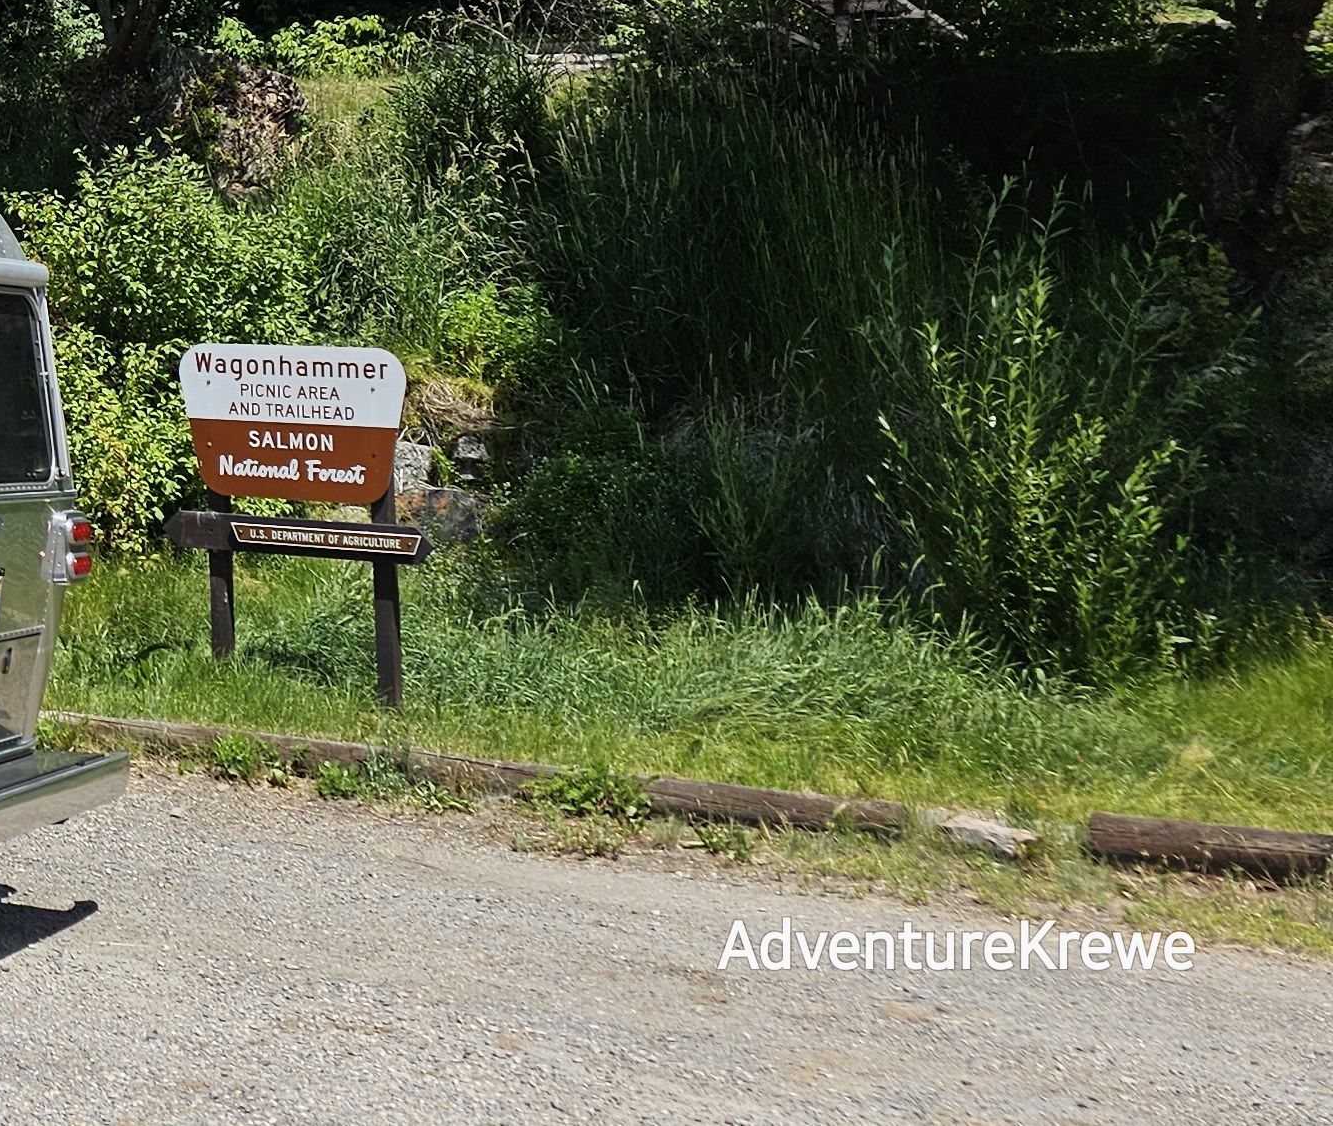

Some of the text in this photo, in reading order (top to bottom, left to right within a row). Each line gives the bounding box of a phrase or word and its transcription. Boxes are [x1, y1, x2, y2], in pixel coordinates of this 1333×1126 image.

[195, 352, 388, 381] Wagonhammer
[240, 383, 340, 401] PICNIC AREA
[229, 402, 355, 421] AND TRAILHEAD
[248, 430, 334, 452] SALMON
[219, 454, 366, 485] National Forest
[249, 529, 401, 549] U.S. DEPARTMENT OF AGRICULTURE
